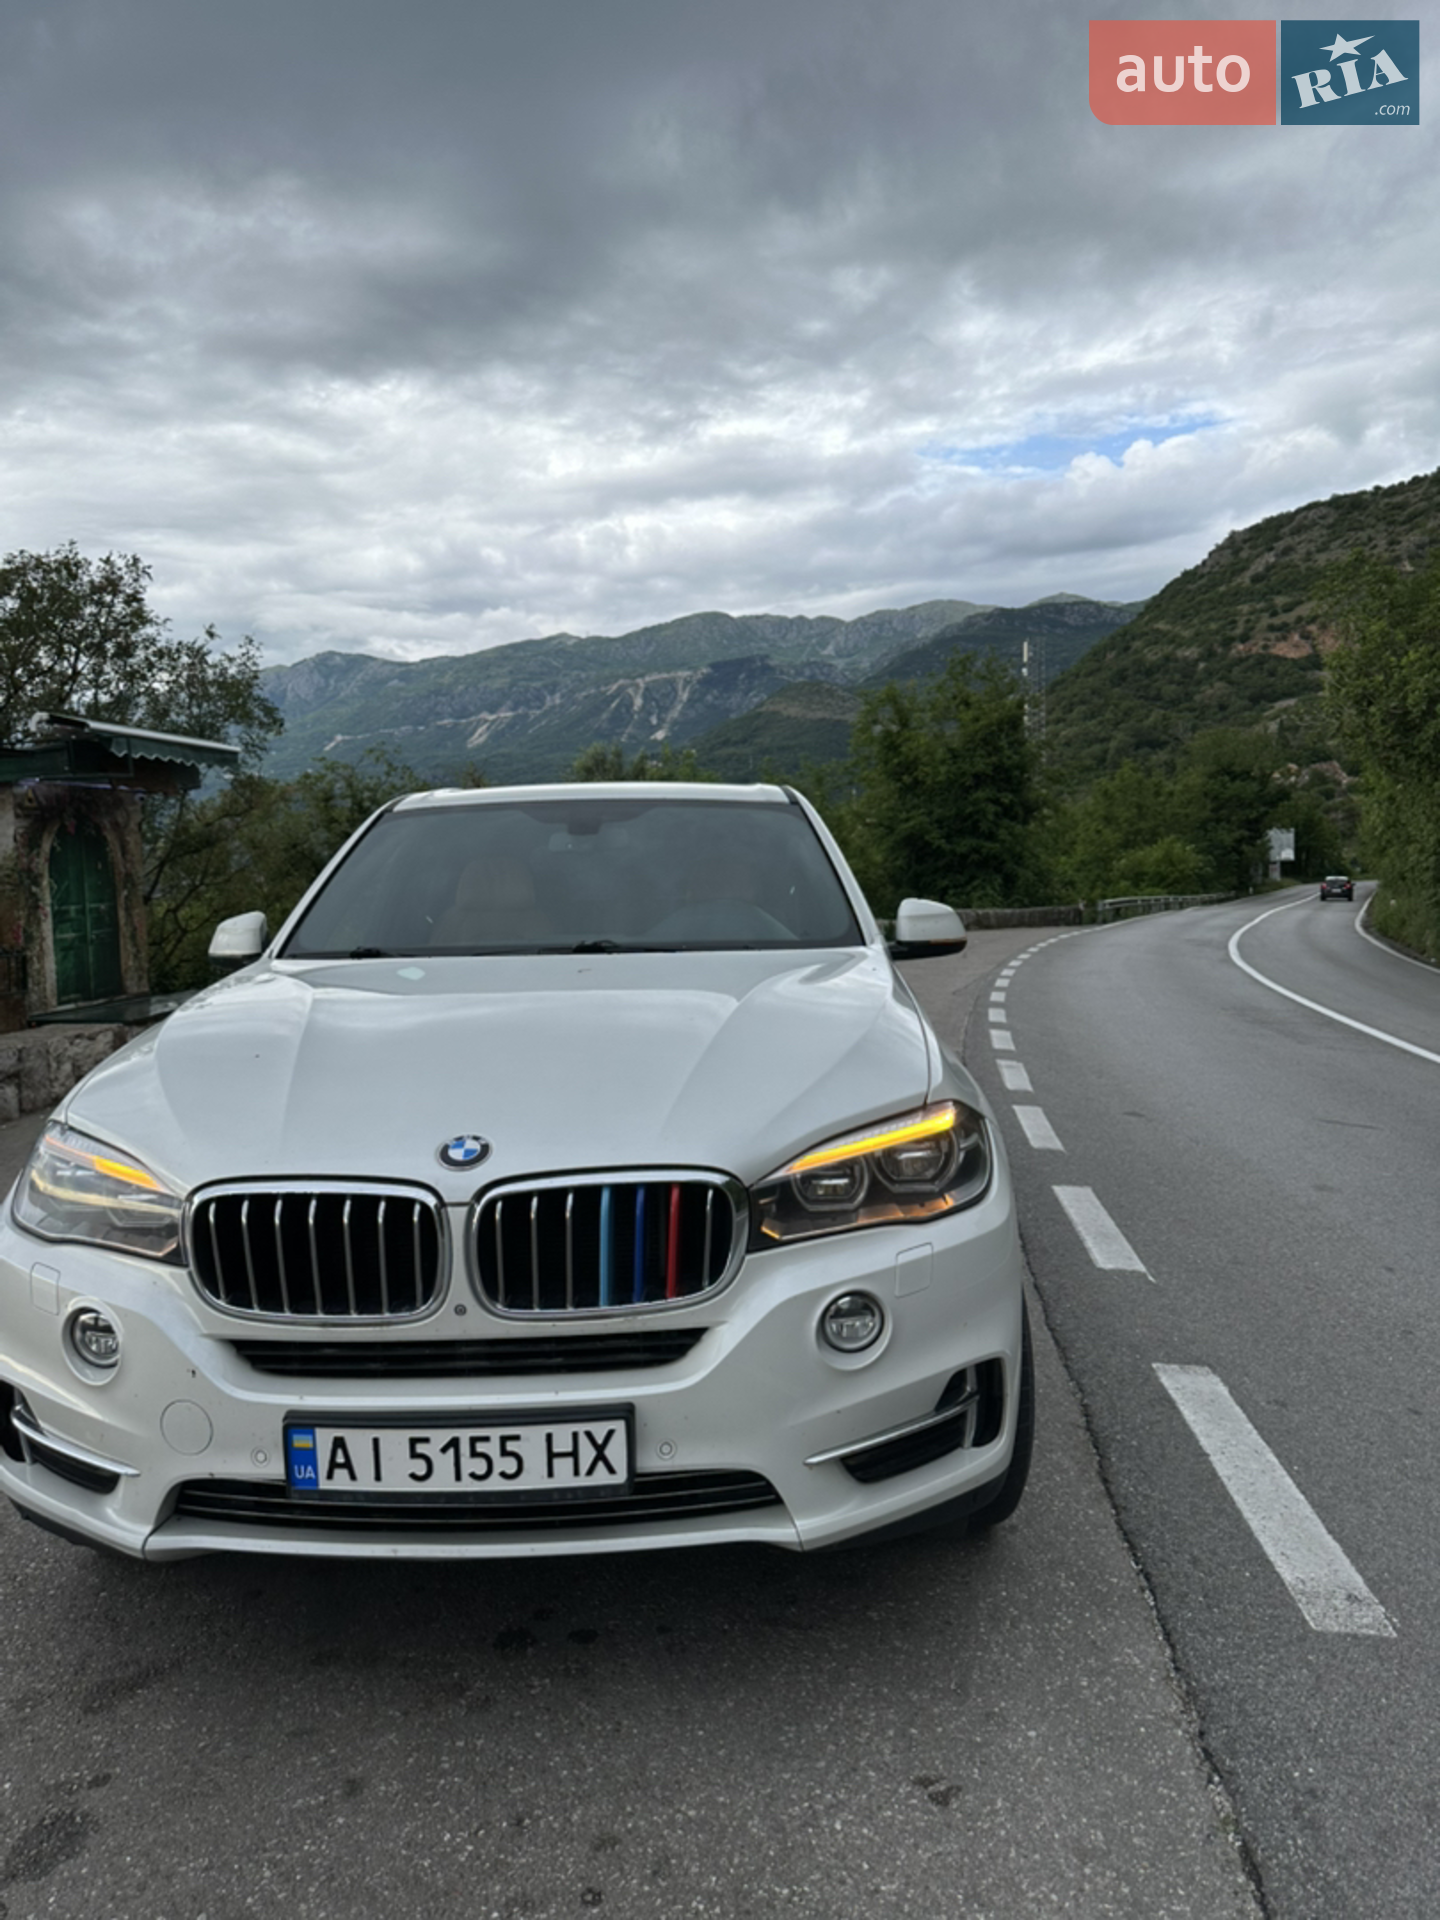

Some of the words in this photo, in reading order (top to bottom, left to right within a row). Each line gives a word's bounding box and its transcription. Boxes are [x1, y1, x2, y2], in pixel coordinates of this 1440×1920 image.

[326, 1436, 382, 1482] AI
[408, 1434, 524, 1482] 5155
[545, 1428, 617, 1479] HX
[294, 1465, 316, 1480] UA
